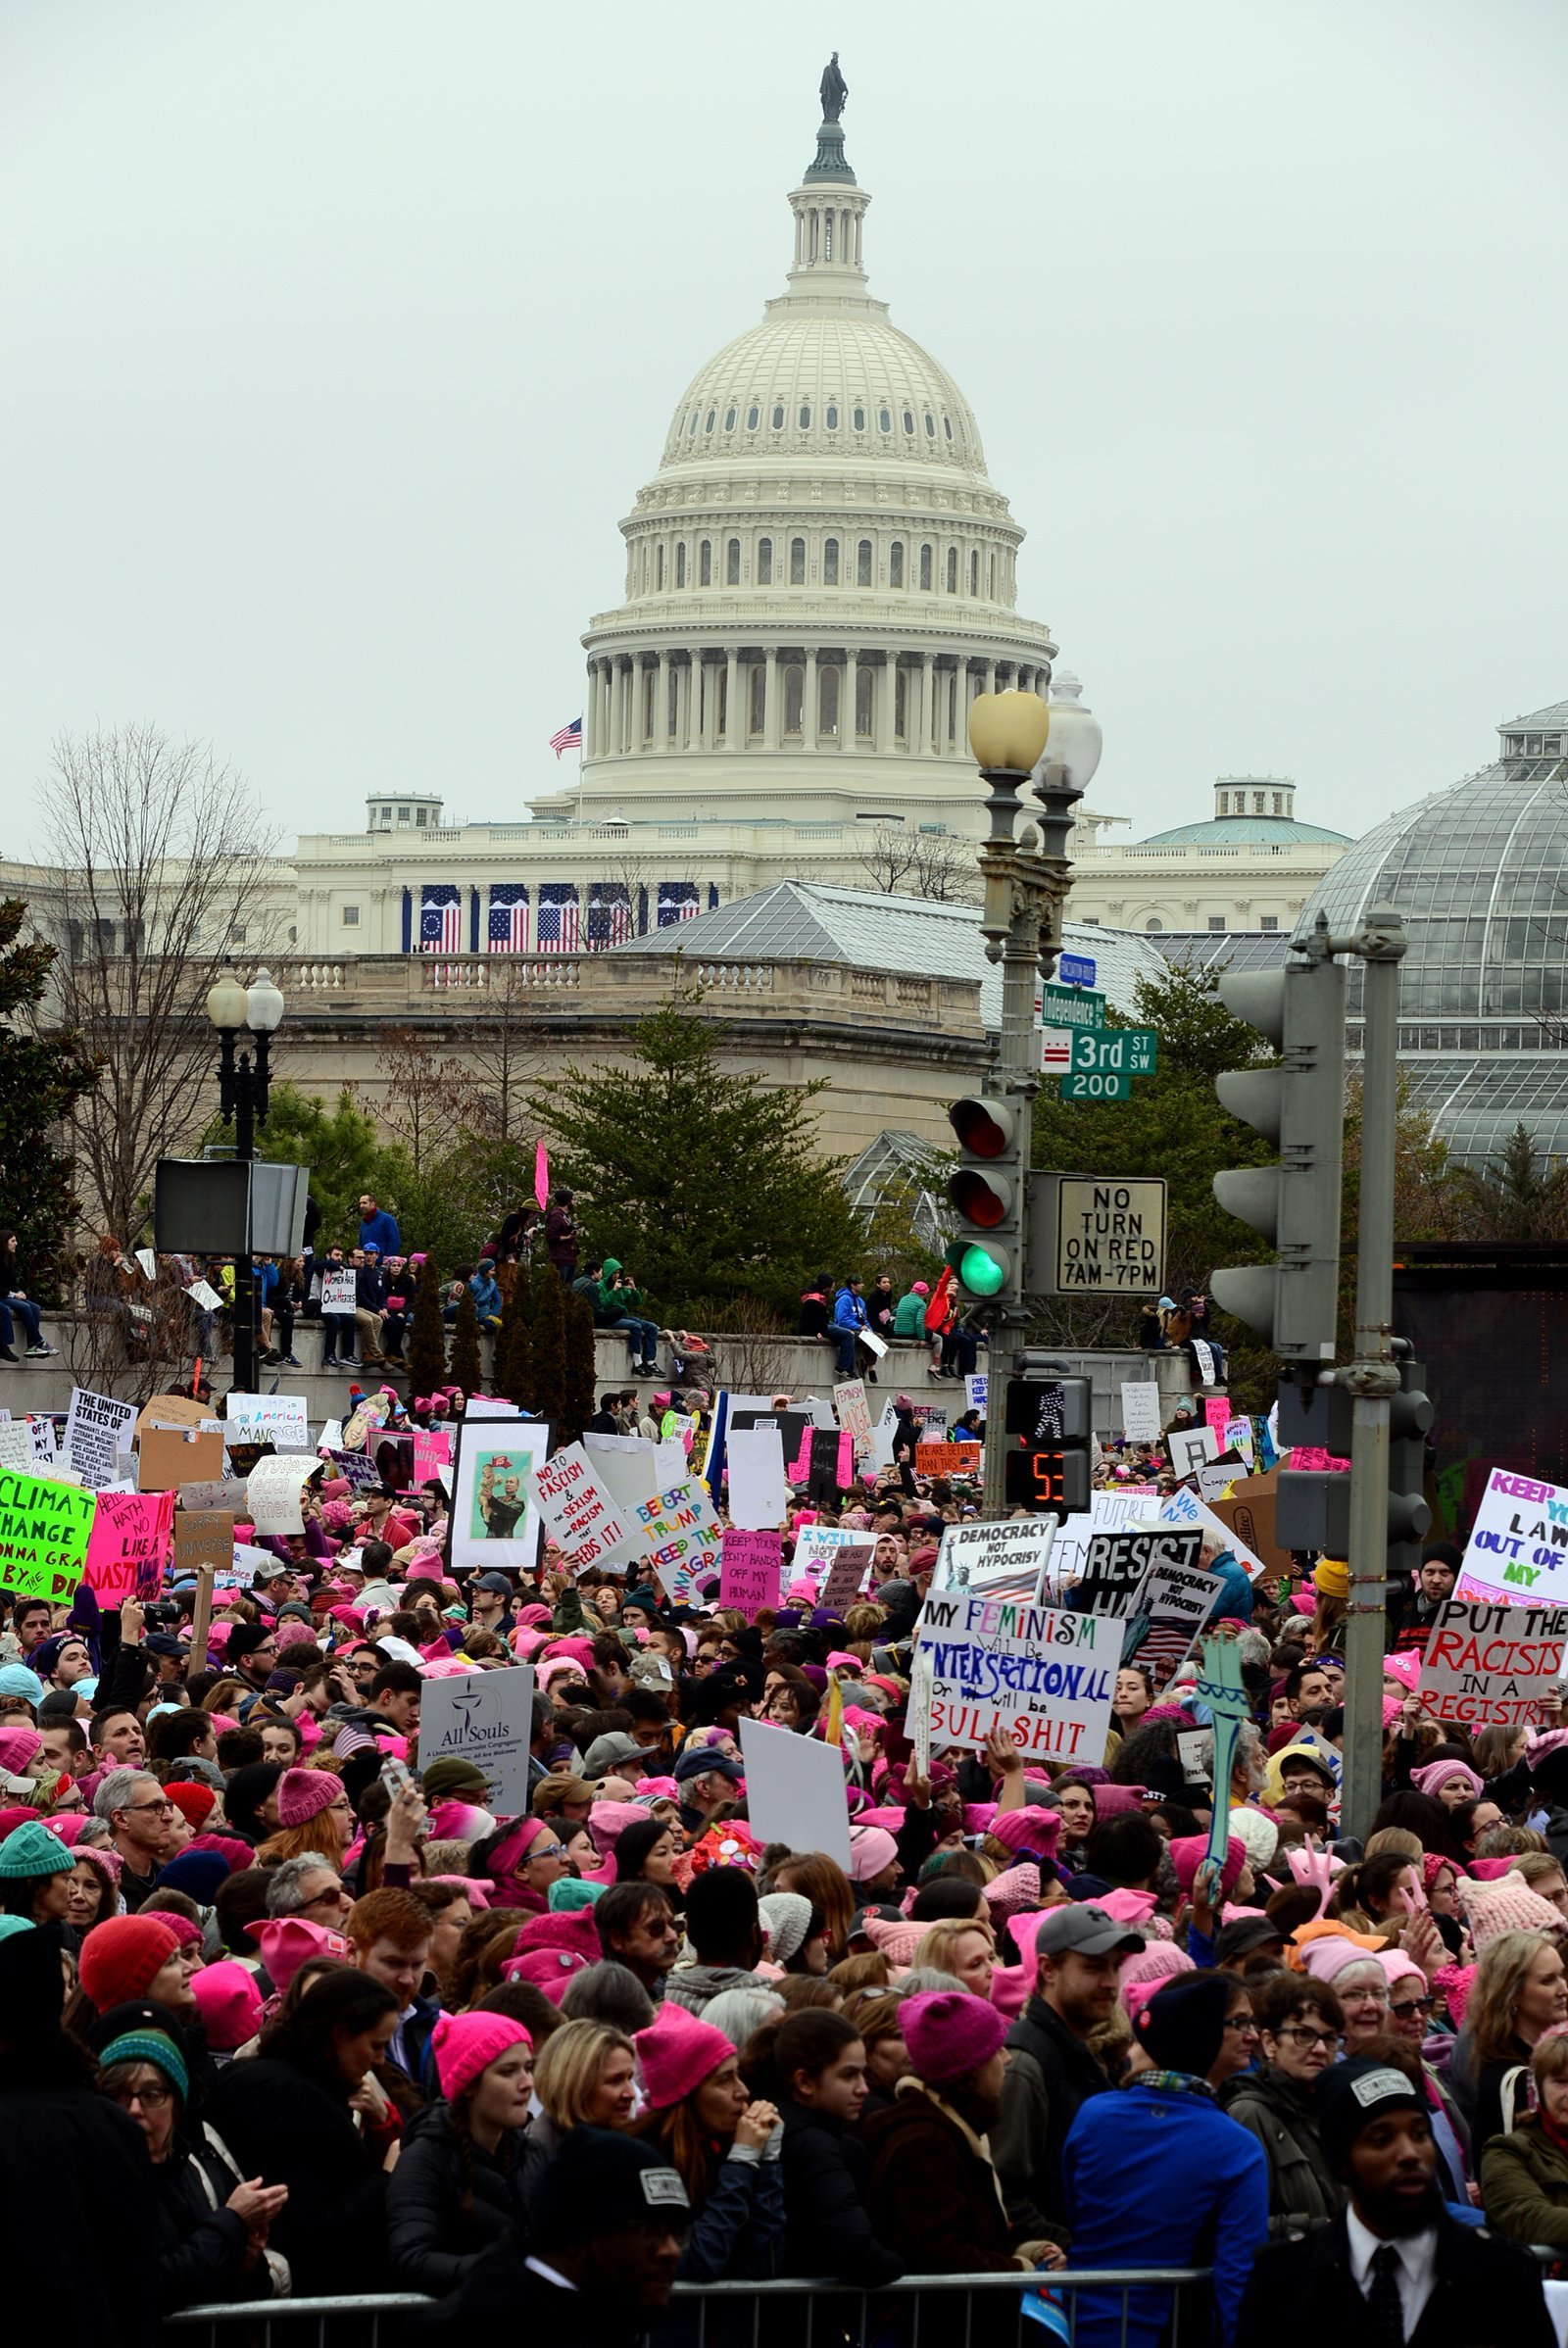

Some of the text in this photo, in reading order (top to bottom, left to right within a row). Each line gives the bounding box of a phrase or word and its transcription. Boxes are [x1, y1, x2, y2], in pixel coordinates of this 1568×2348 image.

[1044, 988, 1095, 1026] Independence
[1077, 1036, 1150, 1068] 3rd ST
[1130, 1054, 1150, 1069] SW
[1072, 1074, 1120, 1096] 200
[1094, 1188, 1130, 1209] NO
[1081, 1213, 1142, 1235] TURN
[1066, 1238, 1154, 1260] ON RED
[1064, 1262, 1156, 1286] 7AM-7PM
[233, 1394, 285, 1410] TRUMP
[836, 1386, 863, 1403] FEMINISM
[78, 1392, 131, 1420] THE UNITED
[255, 1411, 305, 1423] American
[32, 1422, 48, 1436] OFF
[74, 1405, 123, 1431] STATES OF
[841, 1401, 871, 1438] HUGE
[34, 1438, 48, 1451] MY
[916, 1444, 974, 1456] WE ARE BETTER
[1231, 1438, 1244, 1447] ALL
[415, 1449, 439, 1463] WHY
[917, 1458, 958, 1470] THAN THIS
[249, 1456, 319, 1488] protect
[536, 1455, 567, 1483] NO TO
[538, 1461, 585, 1502] FASCISM
[1491, 1472, 1556, 1504] KEEP
[99, 1494, 124, 1516] HELL
[250, 1495, 294, 1518] other.
[554, 1486, 598, 1523] THE SEXISM
[564, 1490, 574, 1501] &
[636, 1484, 691, 1523] DEPORT
[1176, 1492, 1200, 1520] We
[113, 1499, 144, 1530] HATH
[564, 1501, 605, 1539] AND RACISM
[641, 1503, 702, 1542] TRUMP
[133, 1517, 150, 1537] NO
[578, 1527, 592, 1540] THAT
[601, 1521, 623, 1546] IT!
[804, 1531, 854, 1545] I WILL
[958, 1523, 1050, 1544] DEMOCRACY
[122, 1538, 148, 1557] LIKE
[150, 1537, 159, 1555] A
[177, 1537, 230, 1558] UNIVERSE
[650, 1523, 723, 1569] KEEP THE
[724, 1535, 780, 1550] KEEP YOUR
[808, 1544, 837, 1556] NOT
[986, 1541, 1007, 1553] NOT
[1474, 1530, 1566, 1571] OUT OF
[722, 1551, 779, 1568] TINY HANDS
[977, 1550, 1041, 1568] HYPOCRISY
[1085, 1537, 1200, 1581] RESIST
[3, 1564, 29, 1586] BY
[24, 1571, 44, 1591] THE
[729, 1569, 768, 1584] OFF MY
[1154, 1566, 1218, 1594] DEMOCRACY
[1502, 1561, 1542, 1588] MY
[729, 1587, 765, 1600] HUMAN
[1168, 1585, 1184, 1595] NOT
[924, 1599, 959, 1628] MY
[1158, 1593, 1205, 1616] HYPOCRISY
[1439, 1600, 1568, 1637] PUT THE
[1025, 1641, 1044, 1661] Be
[1458, 1673, 1519, 1697] IN A
[932, 1681, 1048, 1714] Or will be
[441, 1722, 510, 1746] All Souls
[930, 1700, 1086, 1754] BULLSHIT
[458, 1744, 487, 1753] Universalist
[488, 1738, 522, 1748] Congregation
